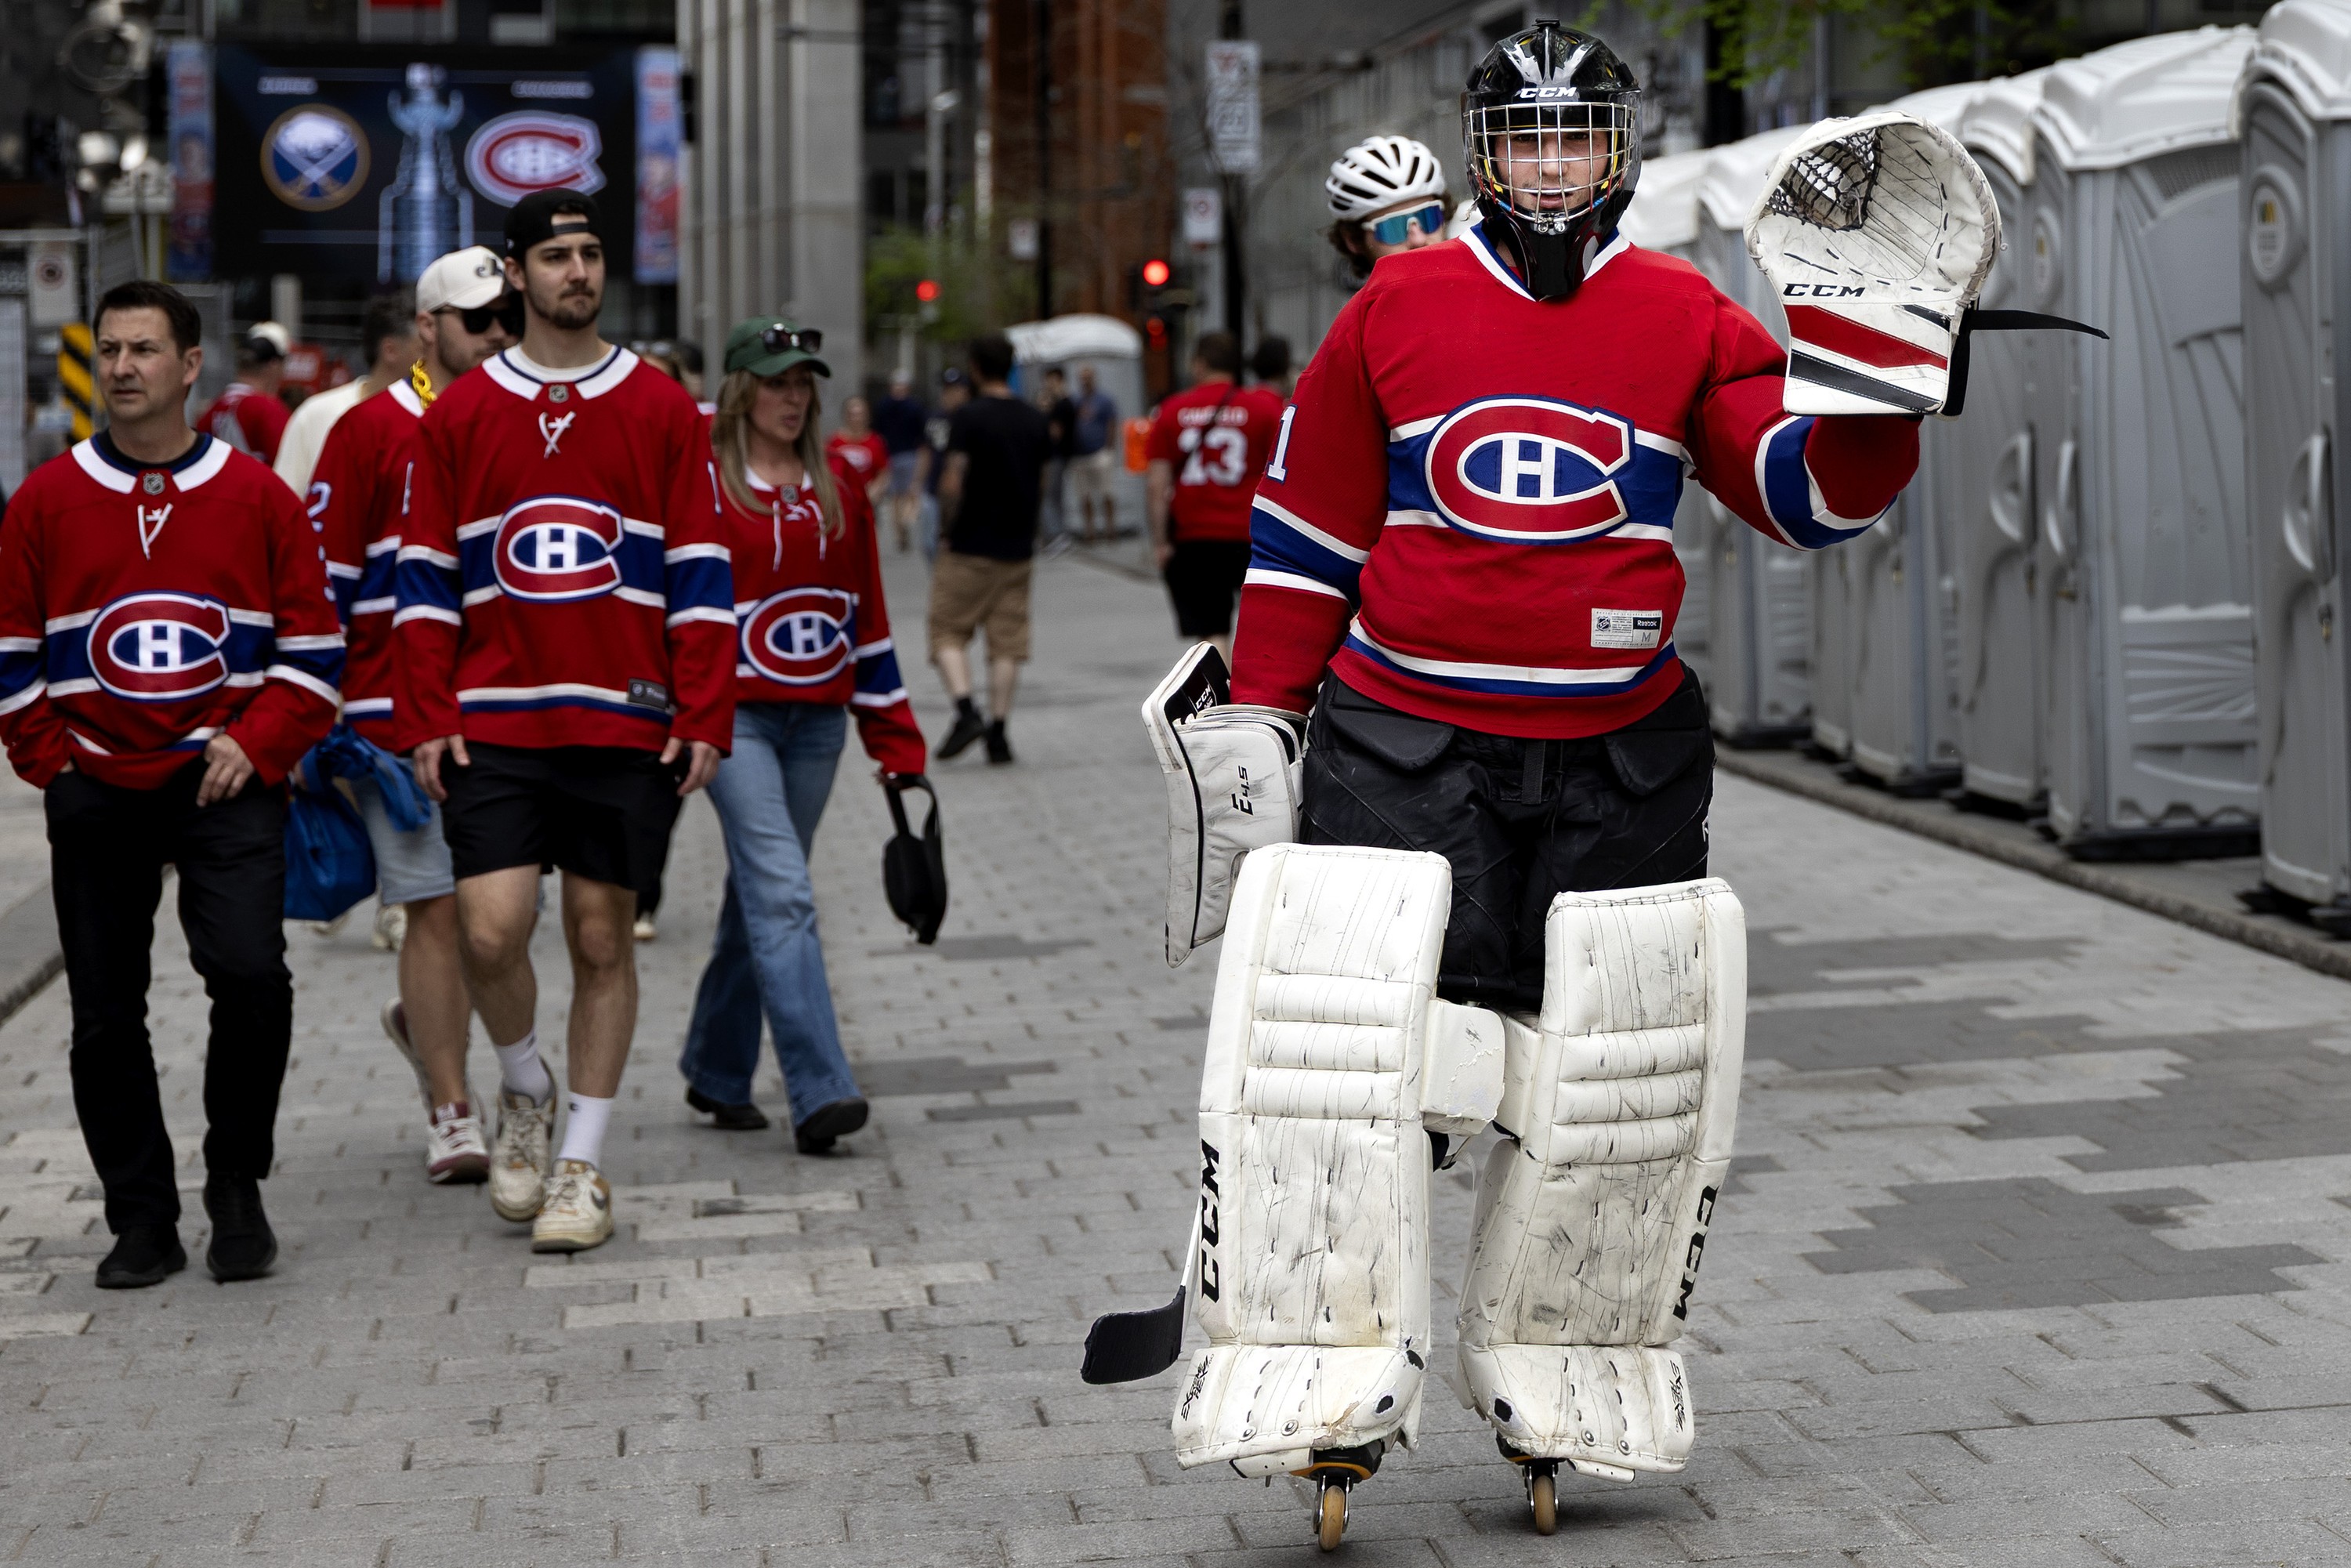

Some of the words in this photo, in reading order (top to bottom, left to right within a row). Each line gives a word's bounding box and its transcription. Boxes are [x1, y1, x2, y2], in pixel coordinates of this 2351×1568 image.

[1520, 86, 1577, 99] CCM
[1783, 283, 1865, 297] CCM
[1642, 632, 1651, 643] M
[1201, 1138, 1219, 1304] CCM
[1672, 1185, 1720, 1322] CCM
